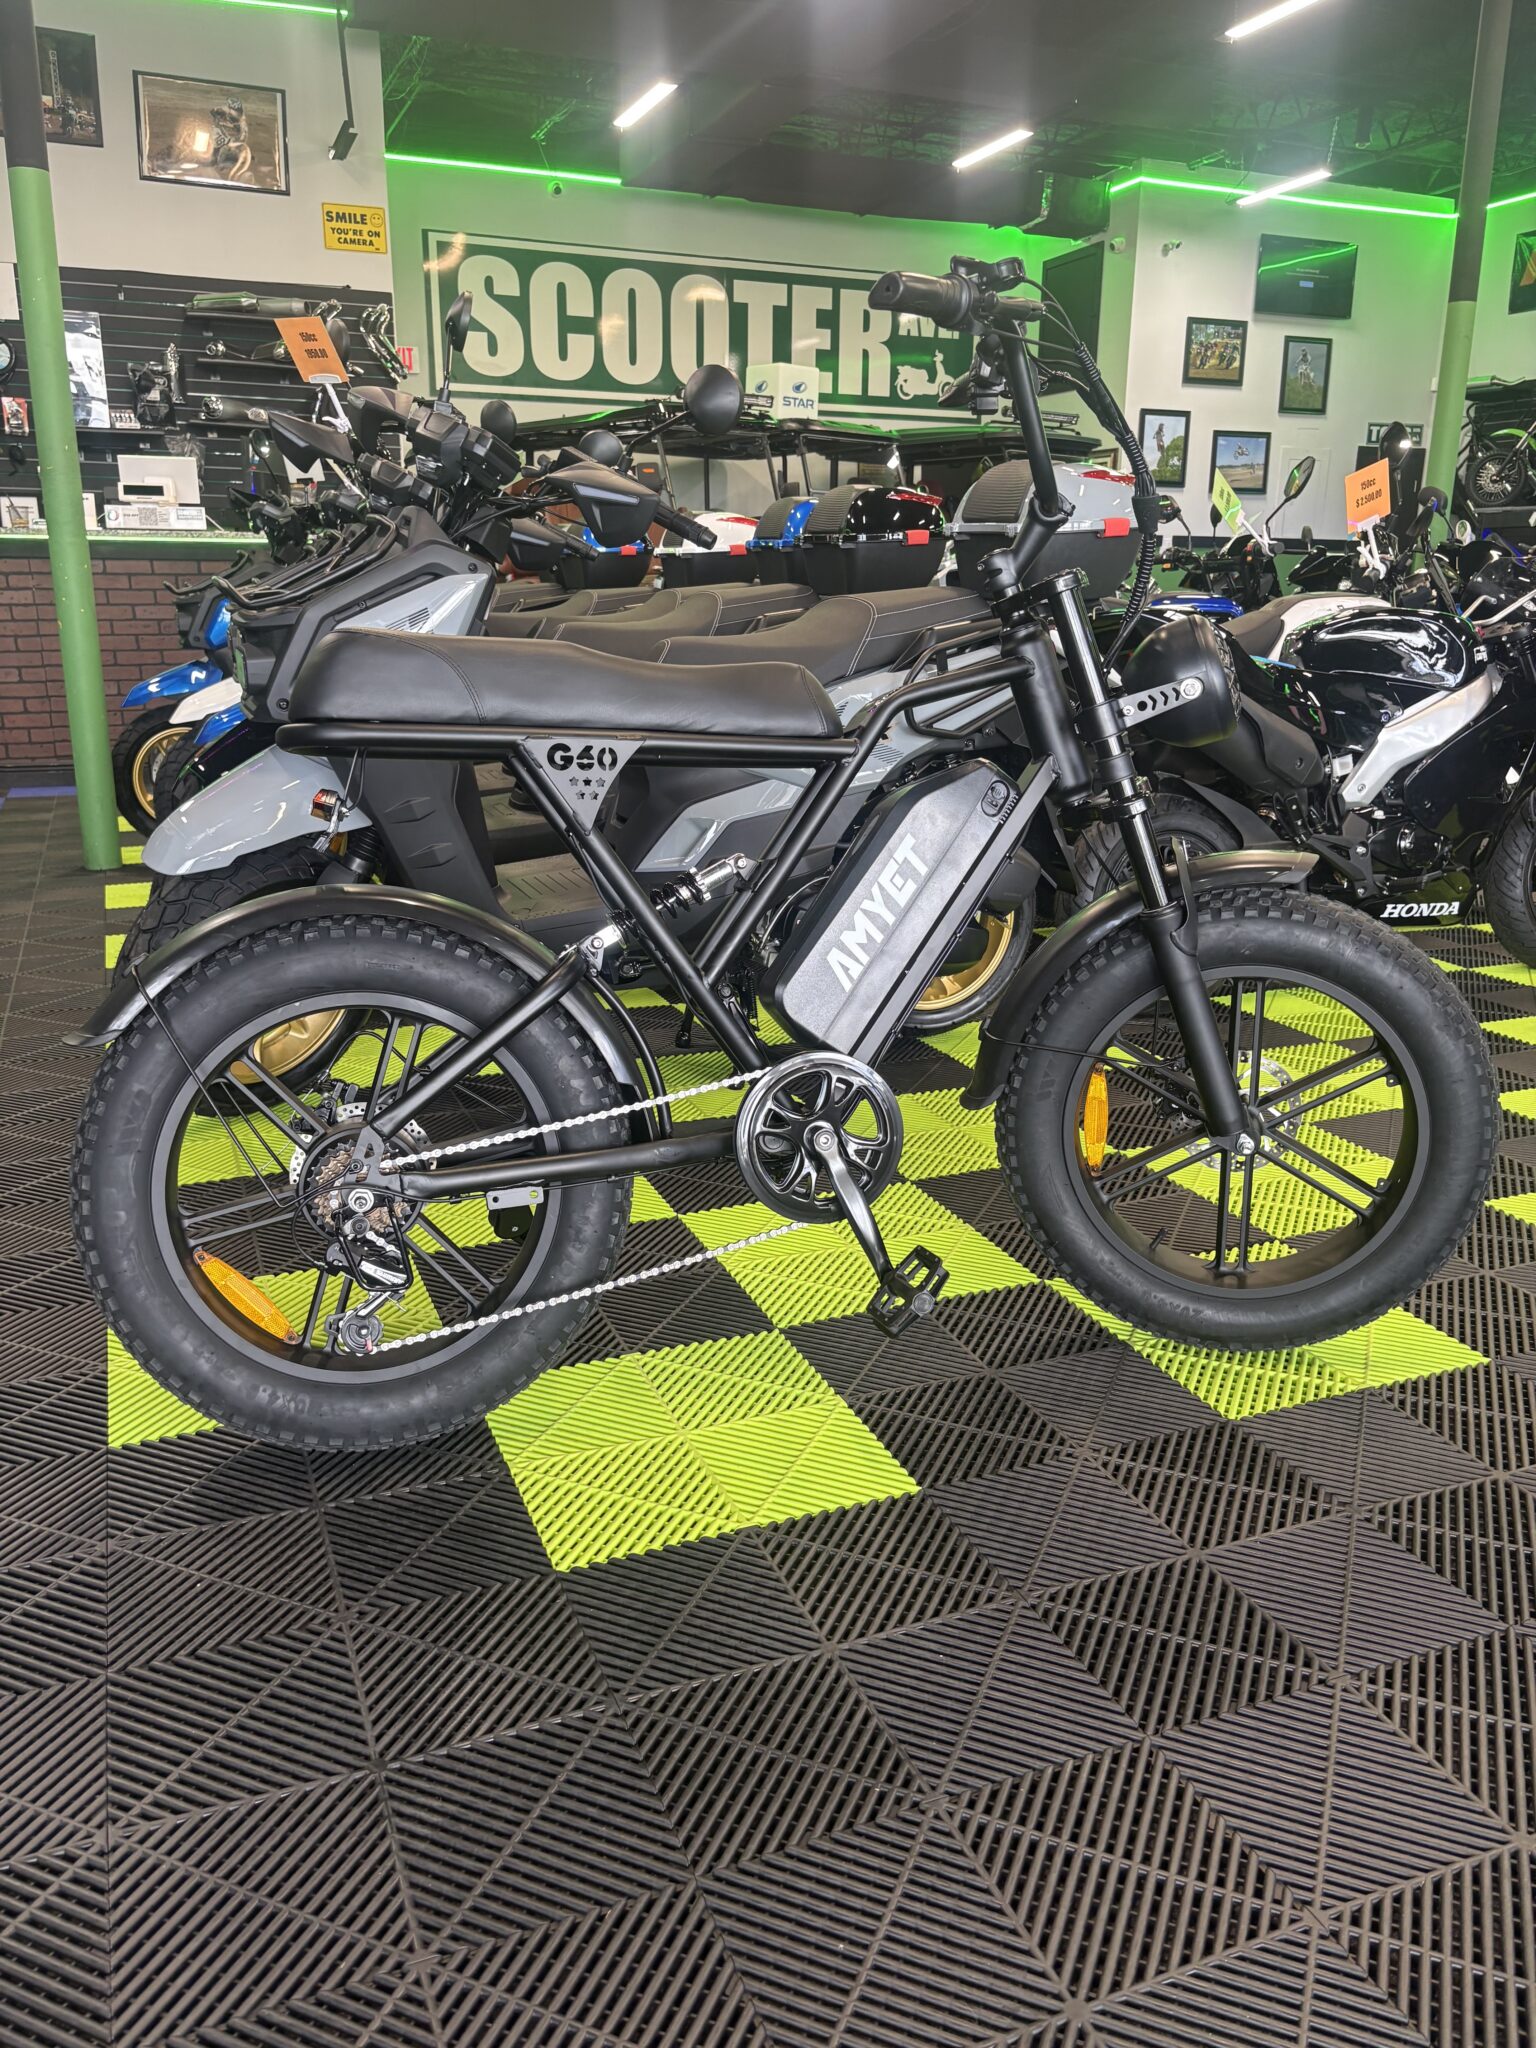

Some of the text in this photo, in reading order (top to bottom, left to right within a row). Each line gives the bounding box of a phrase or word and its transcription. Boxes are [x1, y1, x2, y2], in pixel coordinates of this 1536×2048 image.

[325, 210, 368, 225] SMILE
[330, 226, 381, 239] YOU'RE ON
[337, 236, 375, 247] CAMERA
[457, 254, 892, 398] SCOOTER
[782, 396, 815, 410] STAR
[1360, 478, 1376, 491] 150cc
[546, 742, 618, 772] G60
[826, 832, 929, 993] AMYET
[1380, 901, 1460, 918] HONDA
